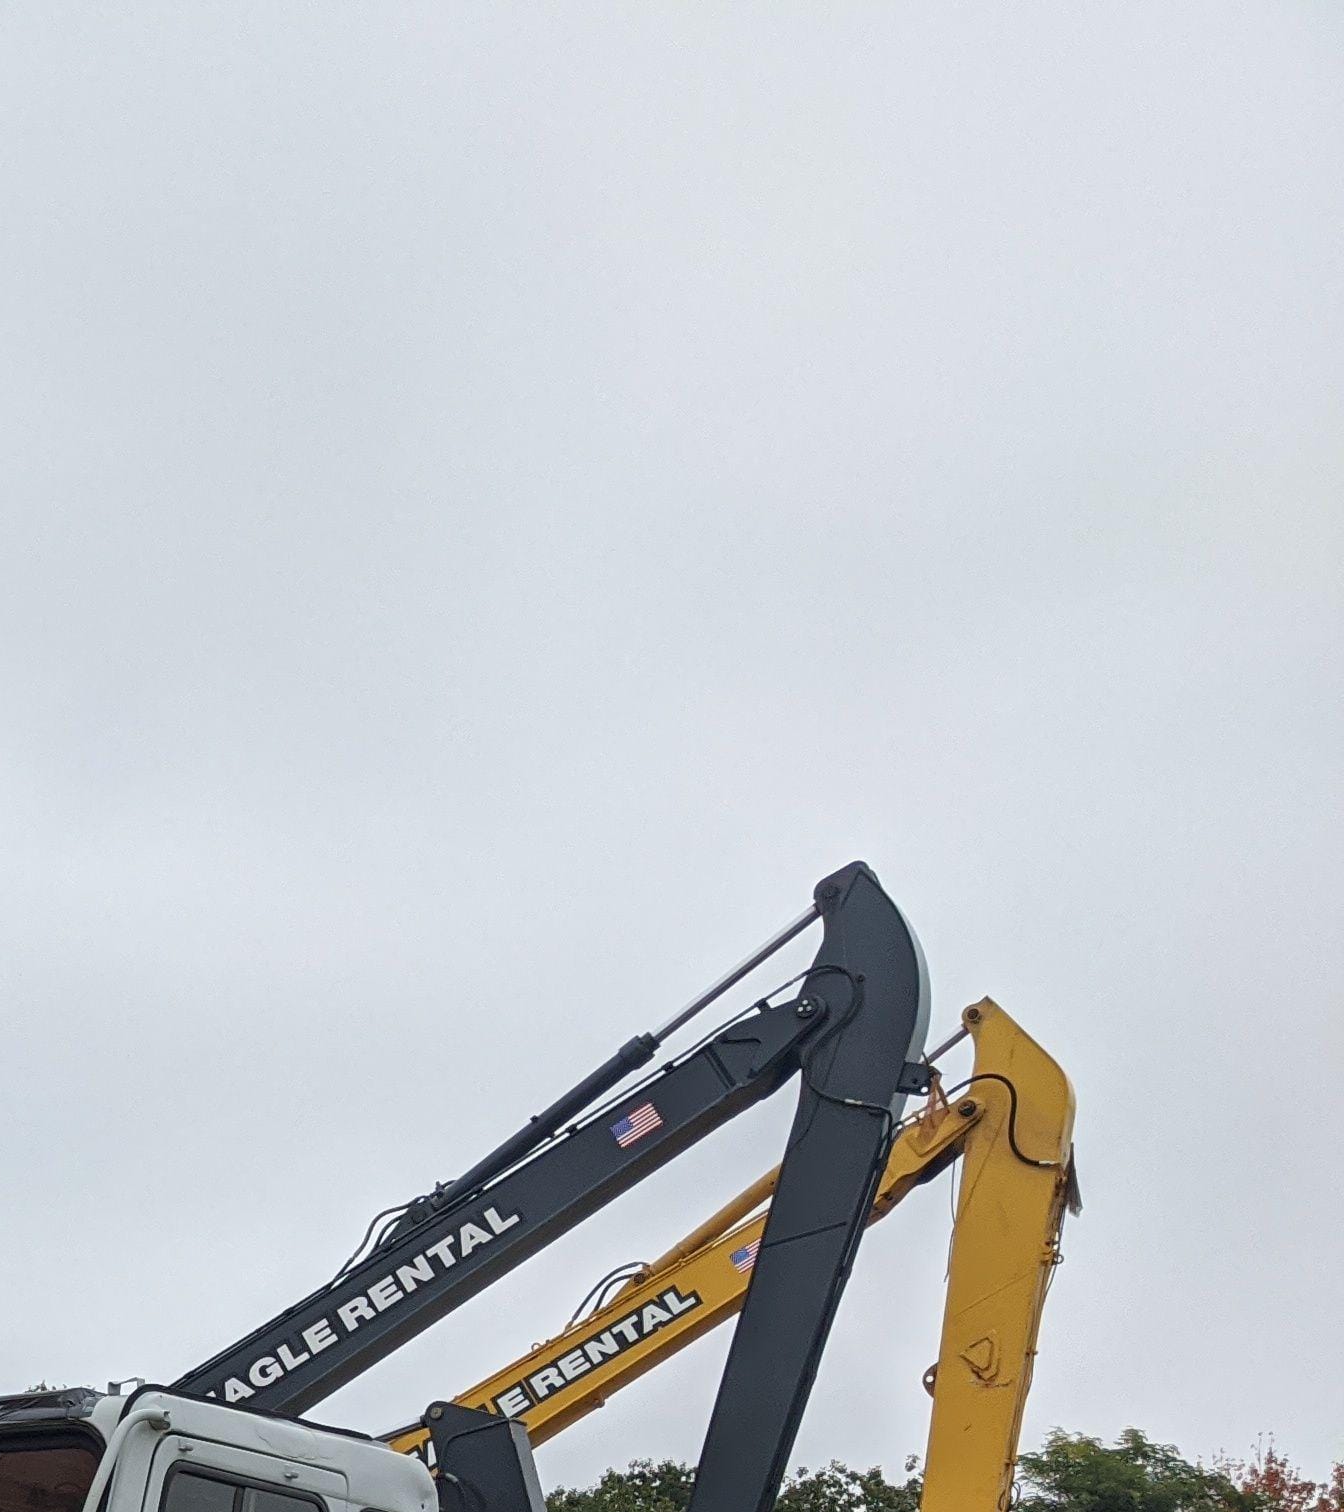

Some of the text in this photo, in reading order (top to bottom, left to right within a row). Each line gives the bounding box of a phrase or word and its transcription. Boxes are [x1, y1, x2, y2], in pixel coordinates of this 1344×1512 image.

[206, 1207, 520, 1402] AGLE RENTAL
[529, 1291, 697, 1398] RENTAL
